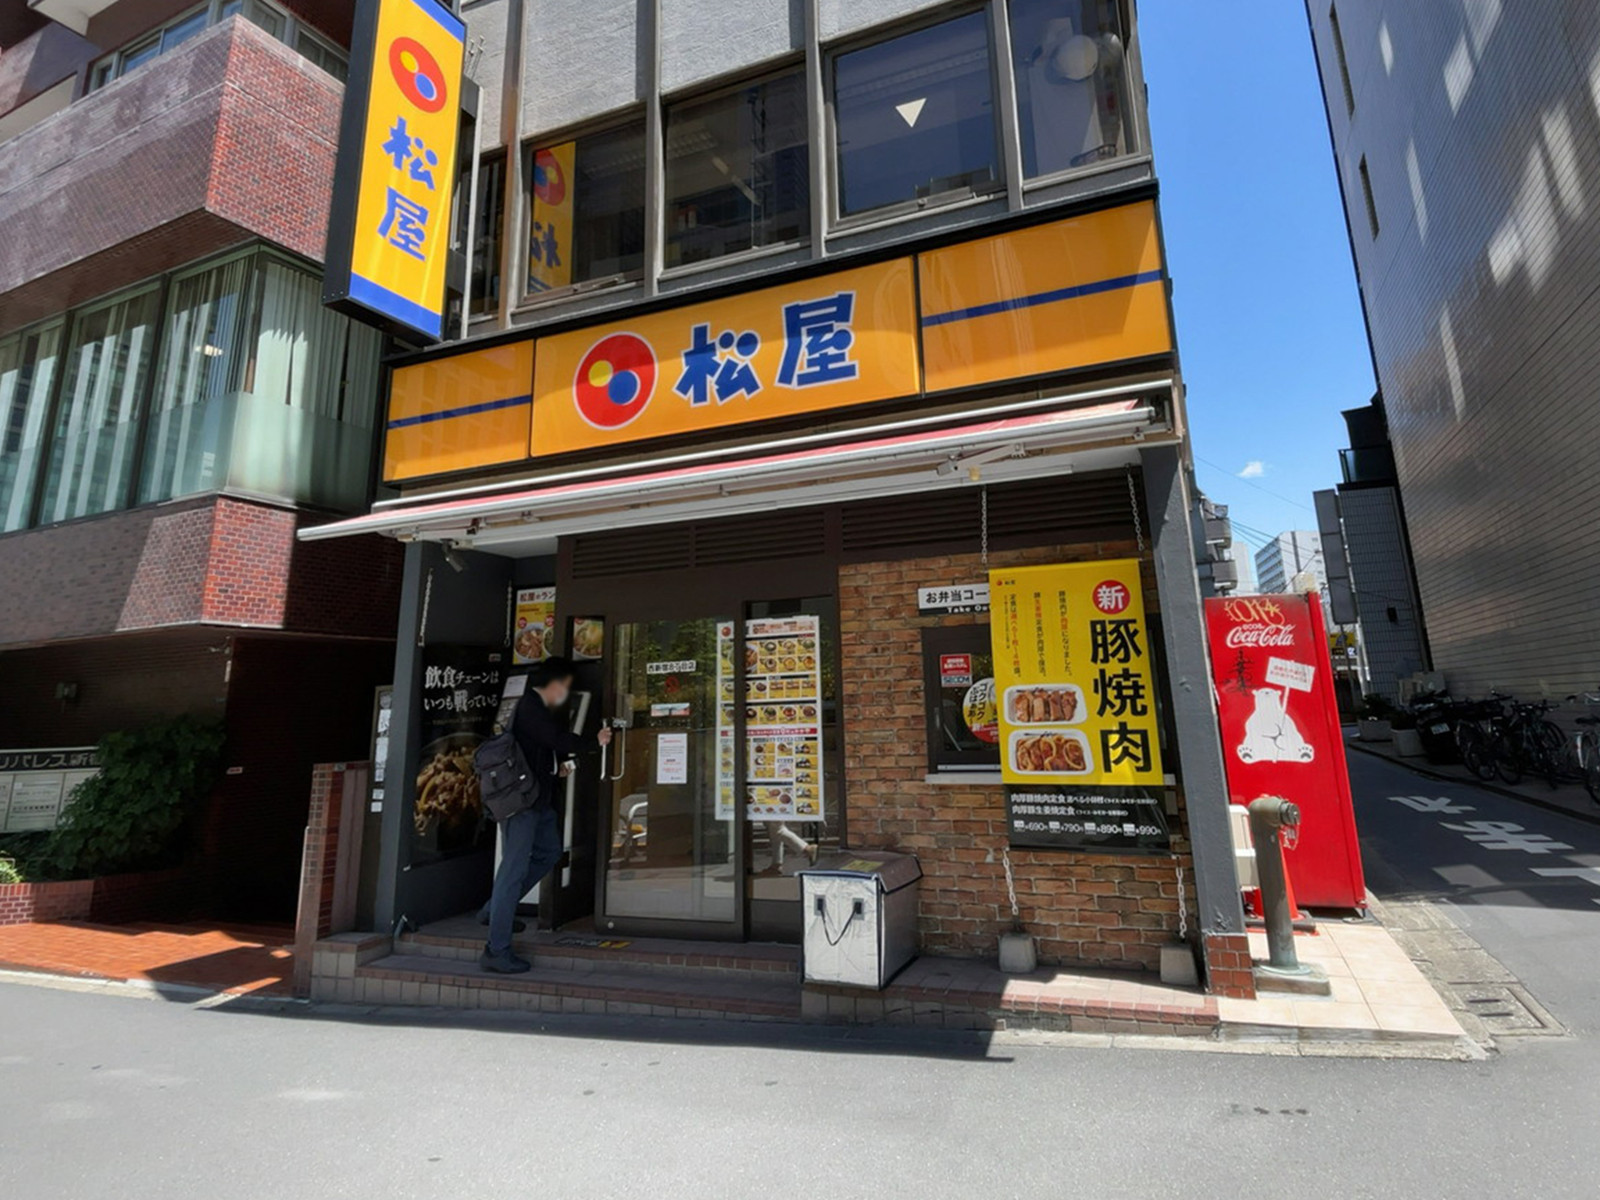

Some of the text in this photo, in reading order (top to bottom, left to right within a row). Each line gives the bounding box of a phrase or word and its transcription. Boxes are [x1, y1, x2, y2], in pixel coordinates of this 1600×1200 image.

[376, 115, 438, 262] 松屋
[672, 290, 860, 408] 松屋
[926, 589, 990, 604] お弁当コー
[1097, 585, 1124, 610] 新
[947, 606, 971, 614] Take
[1226, 624, 1296, 648] Coca-Cola
[424, 665, 500, 689] 飲食チェーンは
[423, 689, 498, 712] いつも戦っている
[1089, 619, 1152, 773] 豚焼肉
